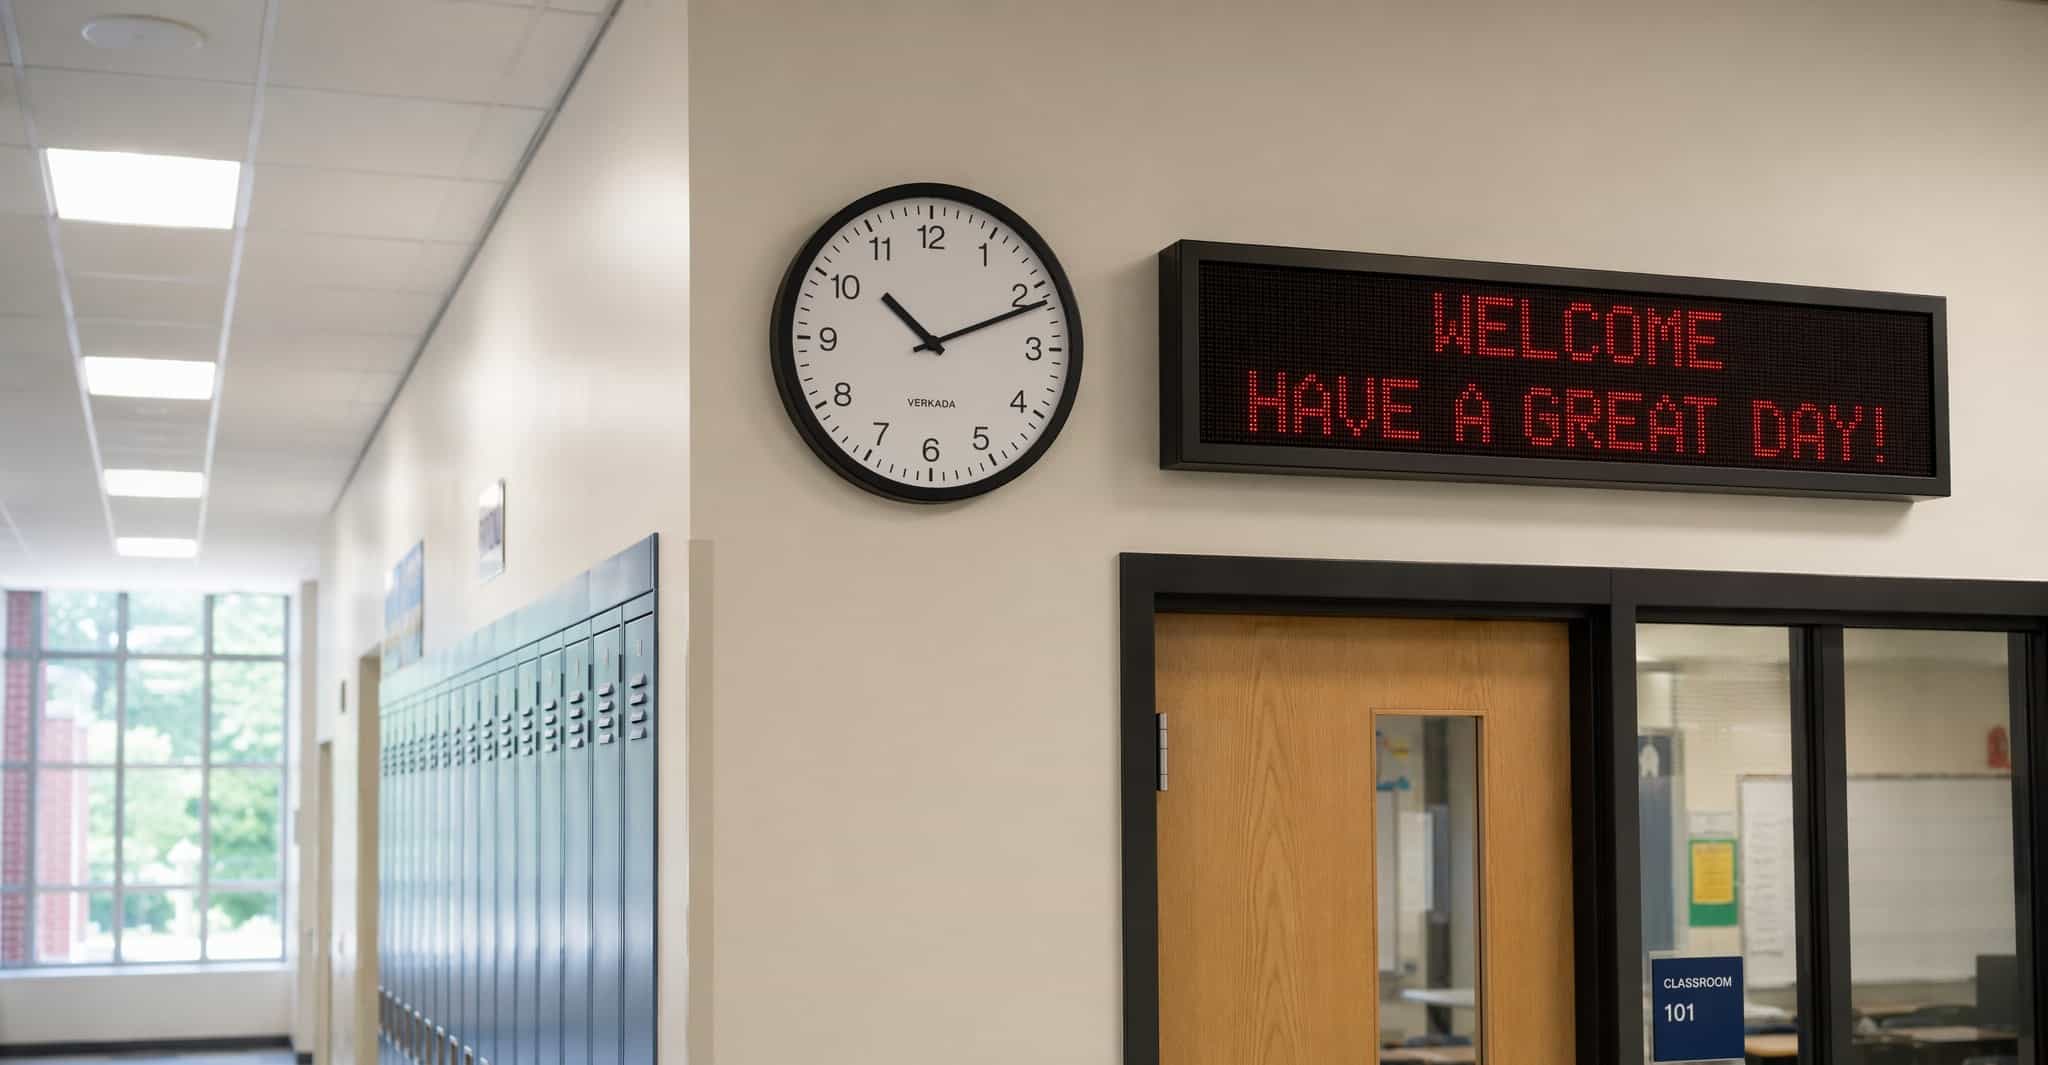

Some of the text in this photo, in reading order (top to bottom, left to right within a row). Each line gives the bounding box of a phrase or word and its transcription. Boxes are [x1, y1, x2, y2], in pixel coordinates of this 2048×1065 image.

[869, 236, 890, 261] 11
[917, 225, 945, 249] 12
[978, 243, 987, 267] 1
[831, 274, 860, 300] 10
[1012, 284, 1028, 307] 2
[820, 327, 837, 351] 9
[1435, 293, 1722, 368] WELCOME
[1025, 337, 1042, 361] 3
[834, 382, 852, 407] 8
[907, 398, 955, 408] VERKADA
[1010, 390, 1027, 413] 4
[1249, 371, 1883, 462] HAVE A GREAT DAY!
[873, 422, 889, 446] 7
[973, 426, 989, 450] 5
[922, 438, 939, 462] 6
[1664, 976, 1731, 988] CLASSROOM
[1665, 1003, 1693, 1022] 101
